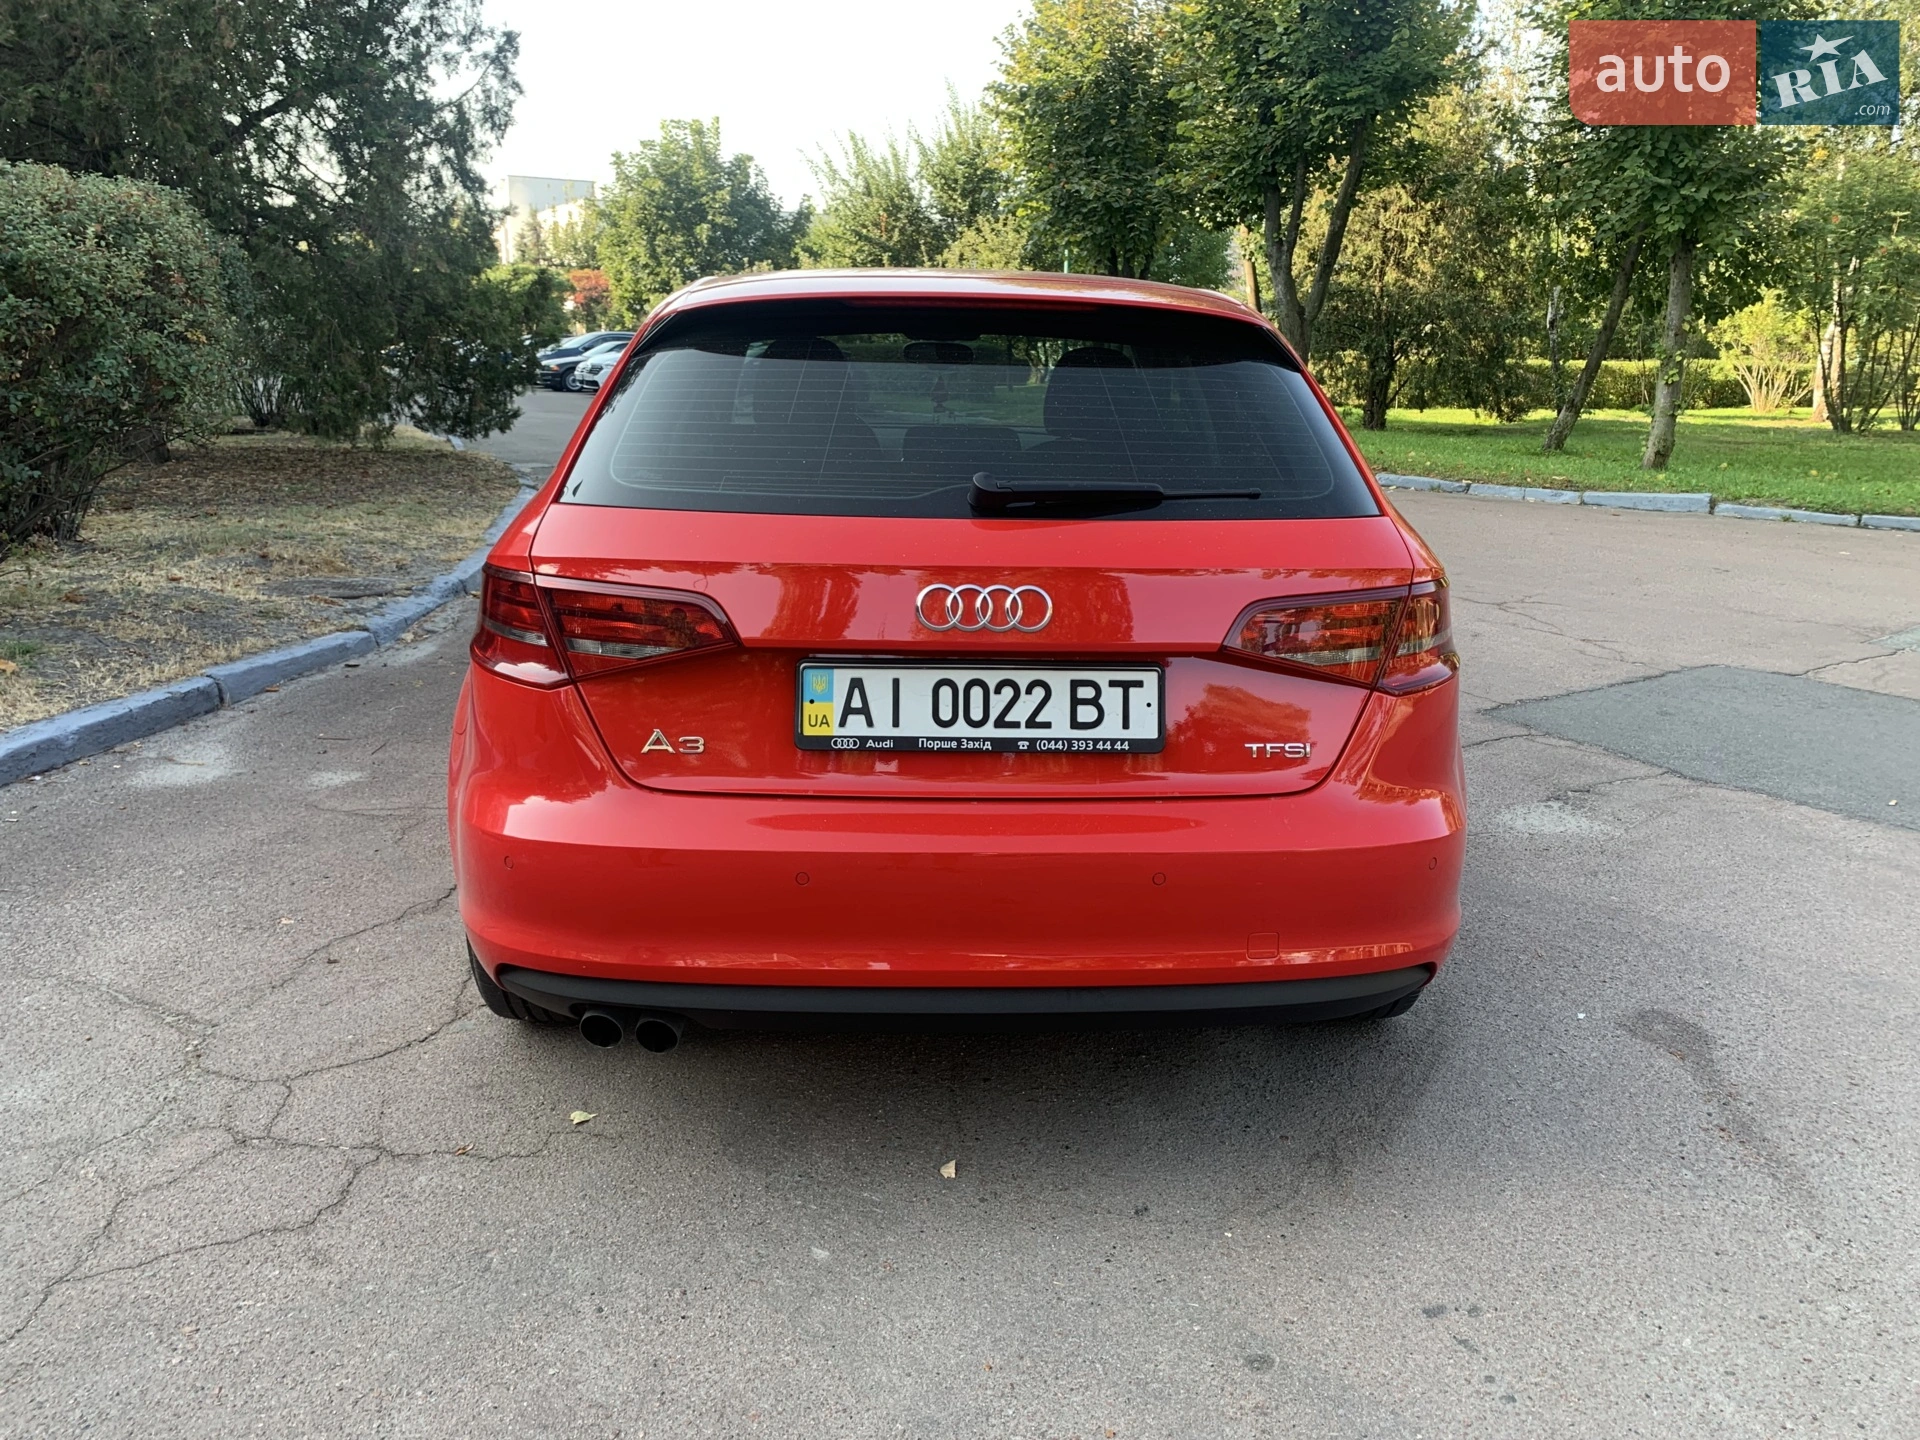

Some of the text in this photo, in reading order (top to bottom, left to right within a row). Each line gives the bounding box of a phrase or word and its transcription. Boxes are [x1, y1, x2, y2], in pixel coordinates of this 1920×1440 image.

[838, 677, 1145, 730] AI 0022 BT
[807, 714, 831, 729] UA
[640, 728, 705, 754] A3
[865, 738, 895, 749] Audi
[918, 738, 993, 752] Порше Захід
[1036, 740, 1130, 752] (044) 393 44 44
[1244, 742, 1312, 759] TFSI
